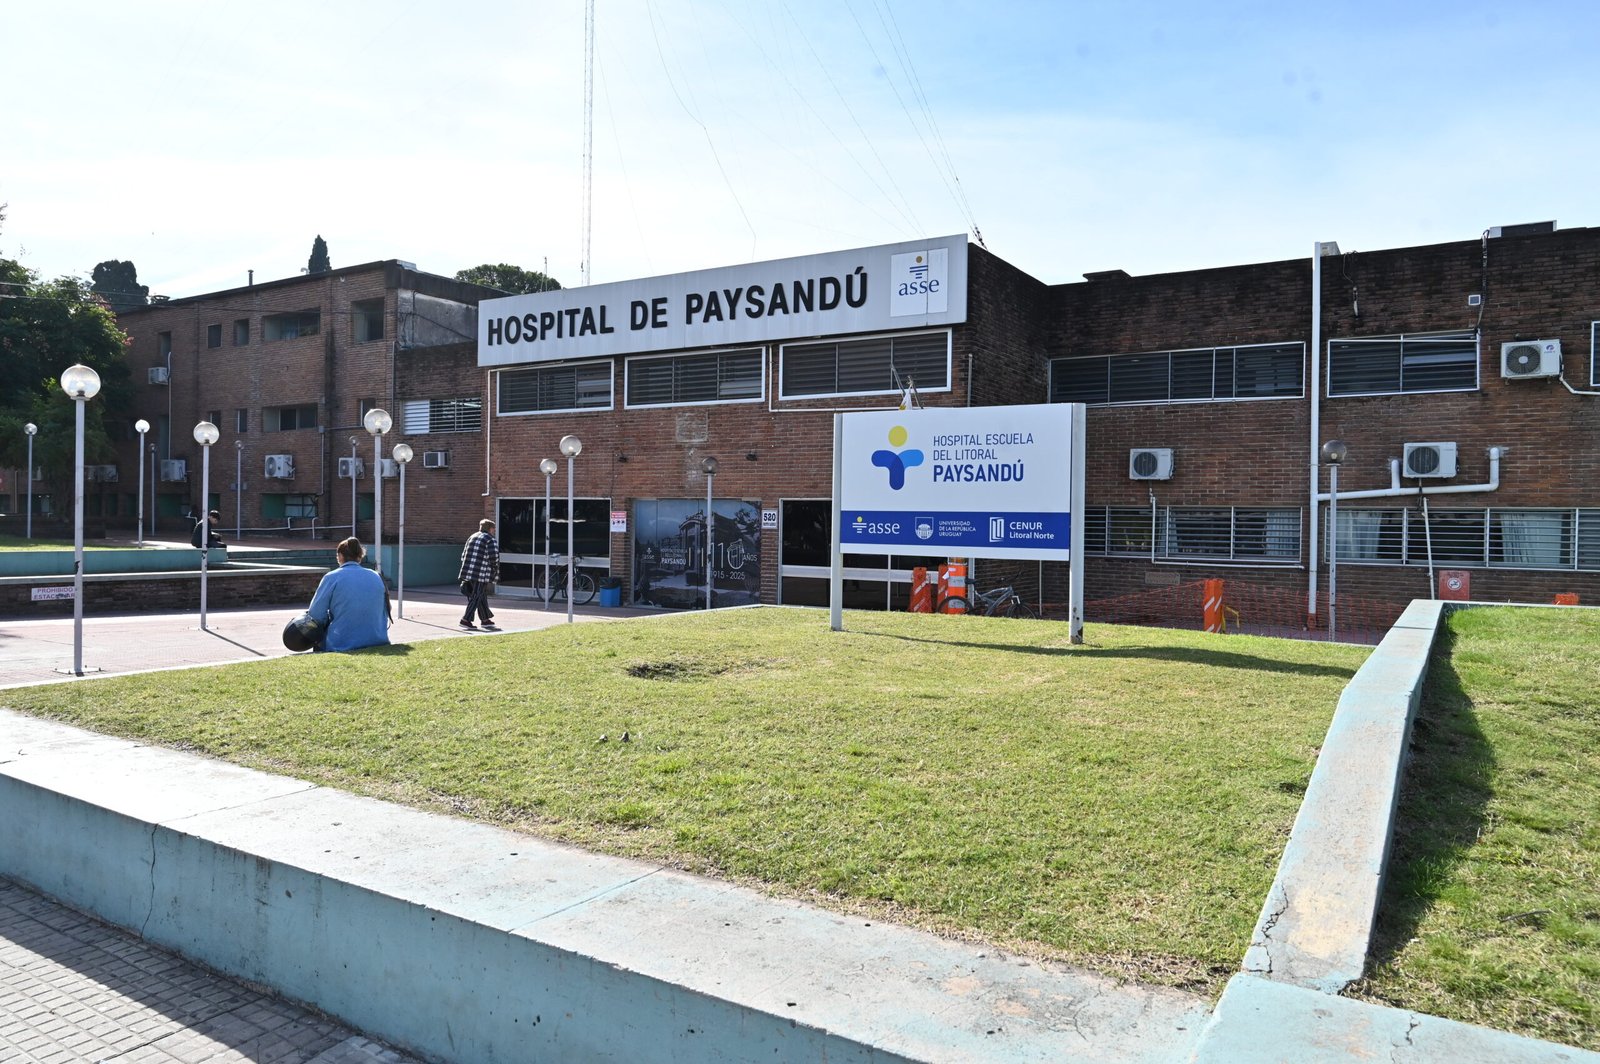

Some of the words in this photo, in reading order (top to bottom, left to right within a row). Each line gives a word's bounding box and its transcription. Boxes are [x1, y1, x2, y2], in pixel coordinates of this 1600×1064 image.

[898, 278, 940, 296] asse
[487, 305, 615, 346] HOSPITAL
[630, 297, 668, 331] DE
[685, 266, 868, 325] PAYSANDÚ
[933, 434, 982, 447] HOSPITAL
[985, 433, 1034, 445] ESCUELA
[933, 449, 952, 461] DEL
[955, 448, 998, 460] LITORAL
[933, 458, 1024, 482] PAYSANDÚ
[763, 512, 776, 521] 520
[868, 522, 900, 534] asse
[1009, 521, 1043, 530] CENUR
[1009, 531, 1032, 539] Litoral
[712, 570, 725, 579] 915
[730, 571, 746, 580] 2025
